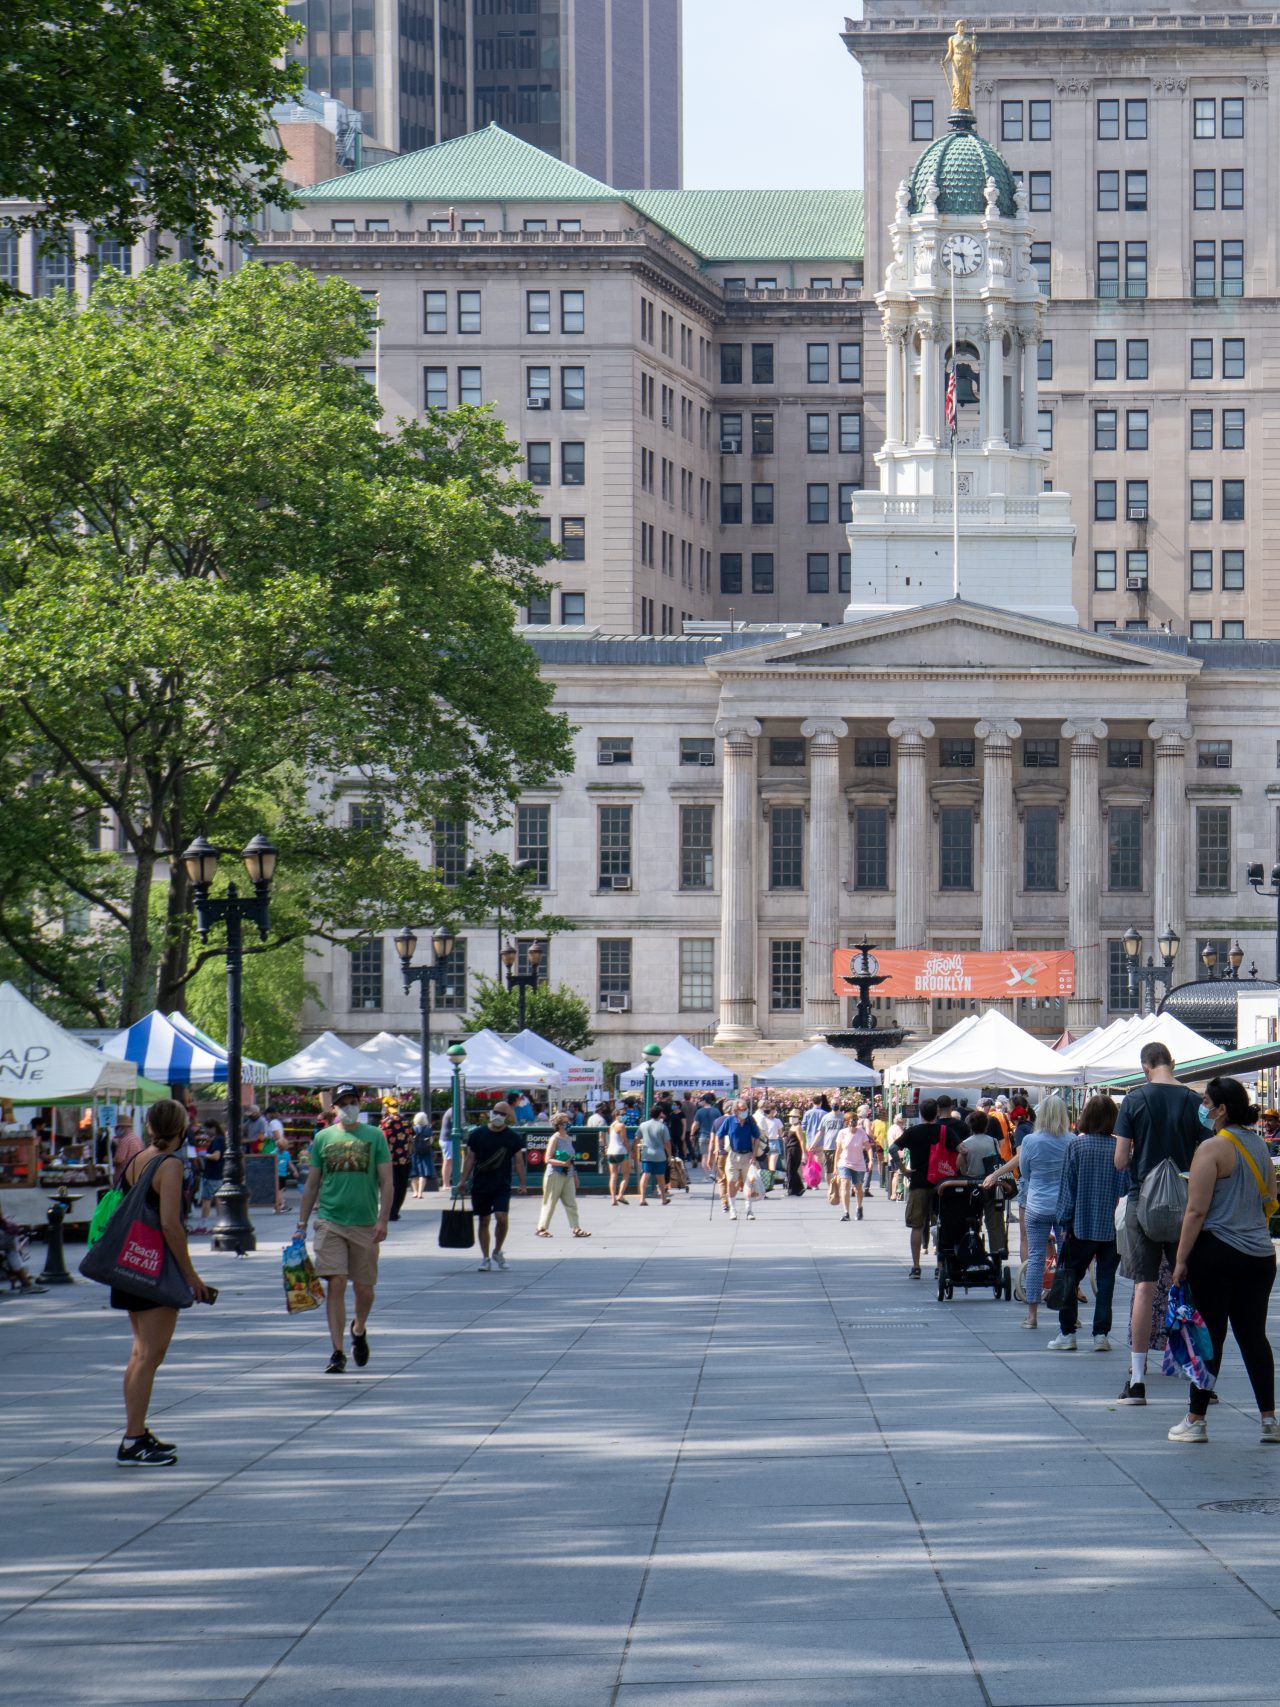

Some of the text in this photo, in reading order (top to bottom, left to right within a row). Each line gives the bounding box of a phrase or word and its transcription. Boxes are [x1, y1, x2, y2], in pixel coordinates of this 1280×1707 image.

[922, 954, 963, 977] STRONG
[915, 976, 972, 991] BROOKLYN
[0, 1046, 50, 1062] AD
[0, 1062, 44, 1080] NE
[630, 1079, 666, 1087] DiPLA
[531, 1152, 539, 1161] 2
[129, 1241, 160, 1260] Teach
[123, 1251, 159, 1271] For All
